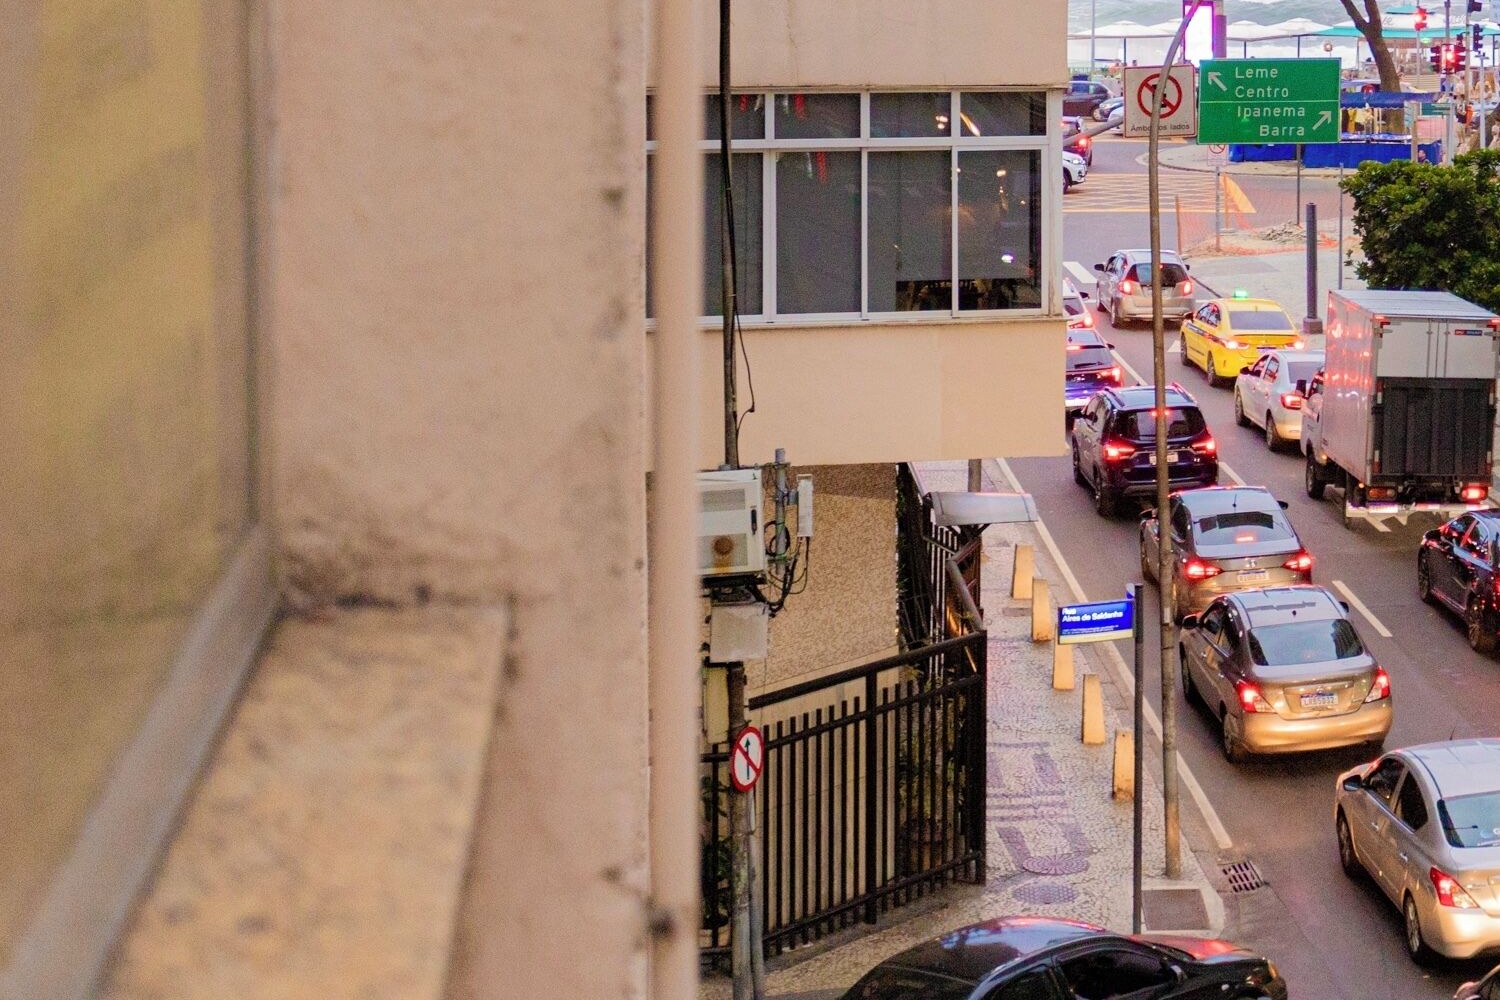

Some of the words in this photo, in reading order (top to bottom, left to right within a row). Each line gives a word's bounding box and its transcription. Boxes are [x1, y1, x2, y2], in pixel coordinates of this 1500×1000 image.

[1235, 67, 1278, 79] Leme
[1235, 86, 1289, 98] Centro
[1237, 105, 1306, 119] Ipanema
[1259, 125, 1305, 136] Barra
